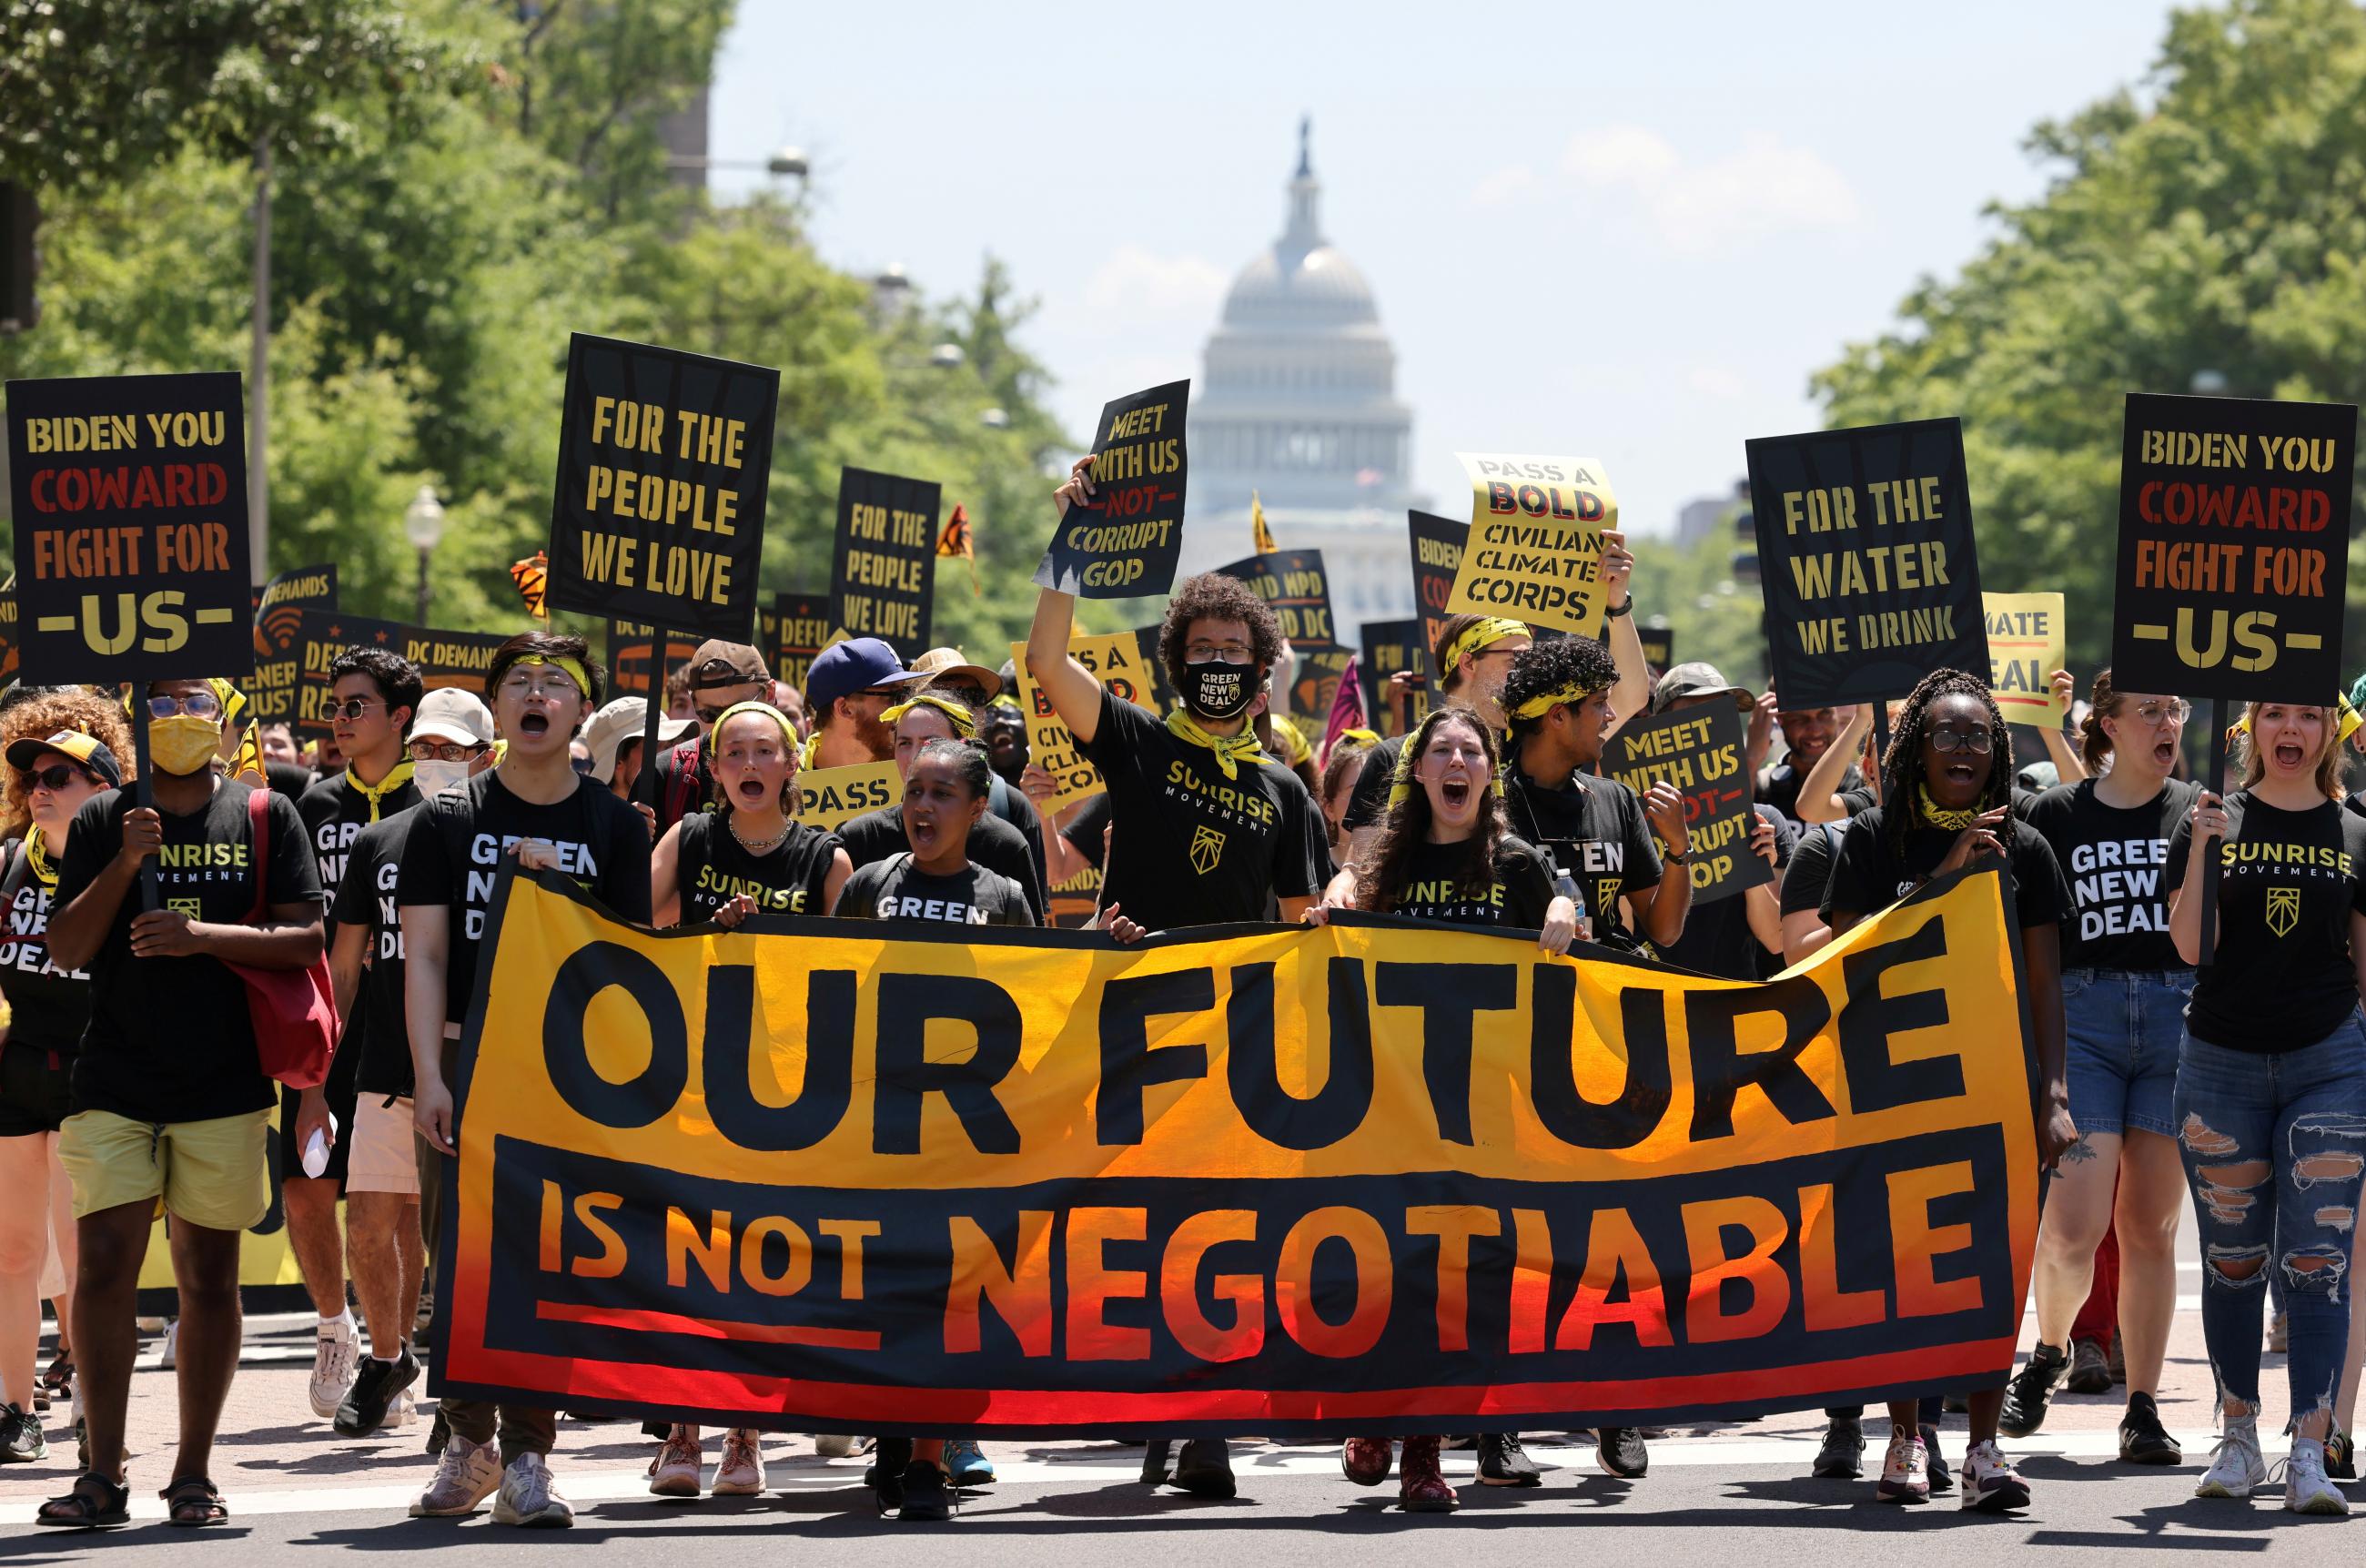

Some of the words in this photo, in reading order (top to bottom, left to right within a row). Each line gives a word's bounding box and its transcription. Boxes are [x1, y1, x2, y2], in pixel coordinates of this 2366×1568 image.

[26, 415, 137, 452] BIDEN
[147, 410, 225, 448] YOU
[592, 396, 664, 454] FOR
[678, 410, 745, 469] THE
[1108, 403, 1168, 441] MEET
[1090, 444, 1143, 483] WITH
[1149, 439, 1179, 474] US
[1478, 460, 1565, 481] PASS
[1575, 468, 1598, 486] A
[2141, 430, 2248, 469] BIDEN
[2258, 435, 2335, 473] YOU
[30, 462, 228, 513] COWARD
[586, 465, 738, 535] PEOPLE
[1488, 481, 1604, 522] BOLD
[1784, 486, 1857, 535] FOR
[1868, 477, 1943, 525] THE
[2139, 481, 2331, 531] COWARD
[850, 502, 886, 541] FOR
[892, 510, 926, 548] THE
[1067, 520, 1173, 553] CORRUPT
[1484, 524, 1604, 554] CIVILIAN
[34, 526, 144, 579] FIGHT
[156, 522, 230, 573] FOR
[582, 530, 637, 587] WE
[646, 541, 732, 604] LOVE
[846, 549, 923, 592] PEOPLE
[1476, 551, 1599, 582] CLIMATE
[1790, 541, 1950, 601] WATER
[2135, 540, 2243, 593] FIGHT
[2253, 546, 2326, 597] FOR
[1083, 558, 1144, 587] GOP
[1283, 571, 1322, 597] MPD
[844, 593, 871, 632] WE
[875, 599, 919, 640] LOVE
[1467, 578, 1590, 621] CORPS
[1302, 607, 1330, 638] DC
[1797, 617, 1849, 655] WE
[1859, 605, 1956, 649] DRINK
[408, 641, 430, 663] DC
[1107, 644, 1128, 670] A
[1199, 693, 1232, 706] DEAL
[1200, 683, 1228, 695] NEW
[1201, 673, 1241, 684] GREEN
[1623, 716, 1713, 761] MEET
[1167, 760, 1274, 825] SUNRISE
[1613, 757, 1694, 798] WITH
[1699, 744, 1739, 781] US
[798, 778, 890, 816] PASS
[1166, 786, 1268, 836] MOVEMENT
[2071, 839, 2169, 874] GREE
[2221, 843, 2352, 875] SUNRISE
[2223, 865, 2348, 884] MOVEMENT
[696, 865, 808, 913] SUNRISE
[877, 895, 989, 926] GREEN
[2075, 870, 2159, 908] NEW
[2081, 904, 2169, 941] DEAL
[542, 941, 1023, 1155] OUR
[1096, 915, 1967, 1150] FUTURE
[540, 1179, 628, 1279] IS
[667, 1206, 881, 1300] NOT
[944, 1160, 1985, 1361] NEGOTIABLE
